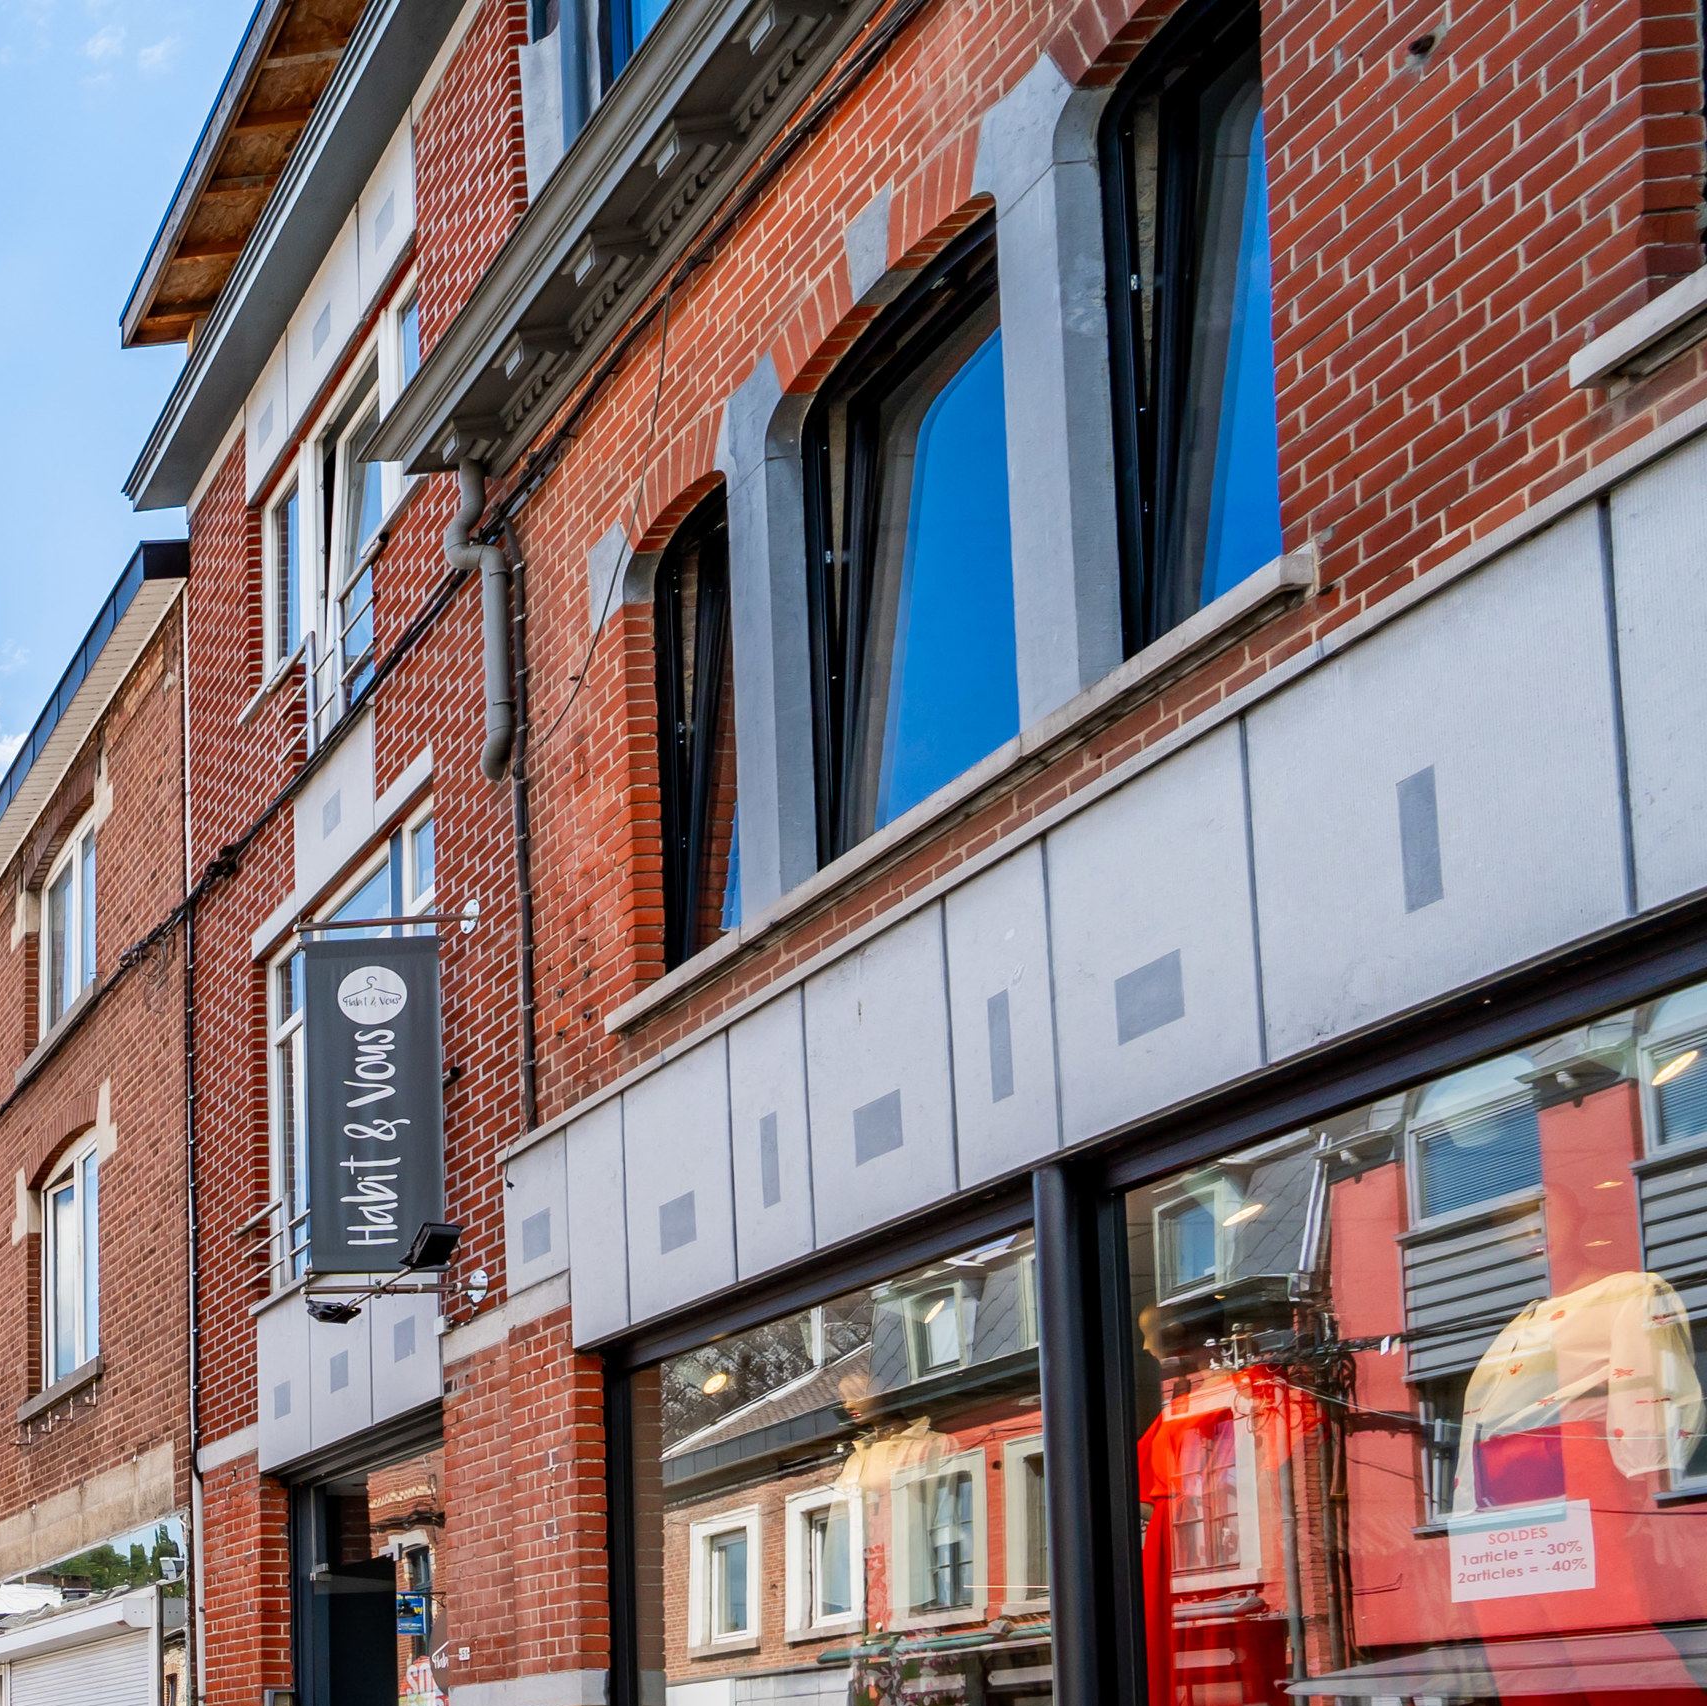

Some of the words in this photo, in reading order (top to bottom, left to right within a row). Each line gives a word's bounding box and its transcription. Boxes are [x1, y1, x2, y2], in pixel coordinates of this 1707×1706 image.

[379, 996, 399, 1005] Vous
[343, 1028, 397, 1108] Vous
[343, 1118, 411, 1142] &
[340, 1154, 402, 1247] Habit
[1488, 1526, 1549, 1545] SOLDES
[1540, 1540, 1583, 1556] -30%
[1545, 1557, 1588, 1573] -40%
